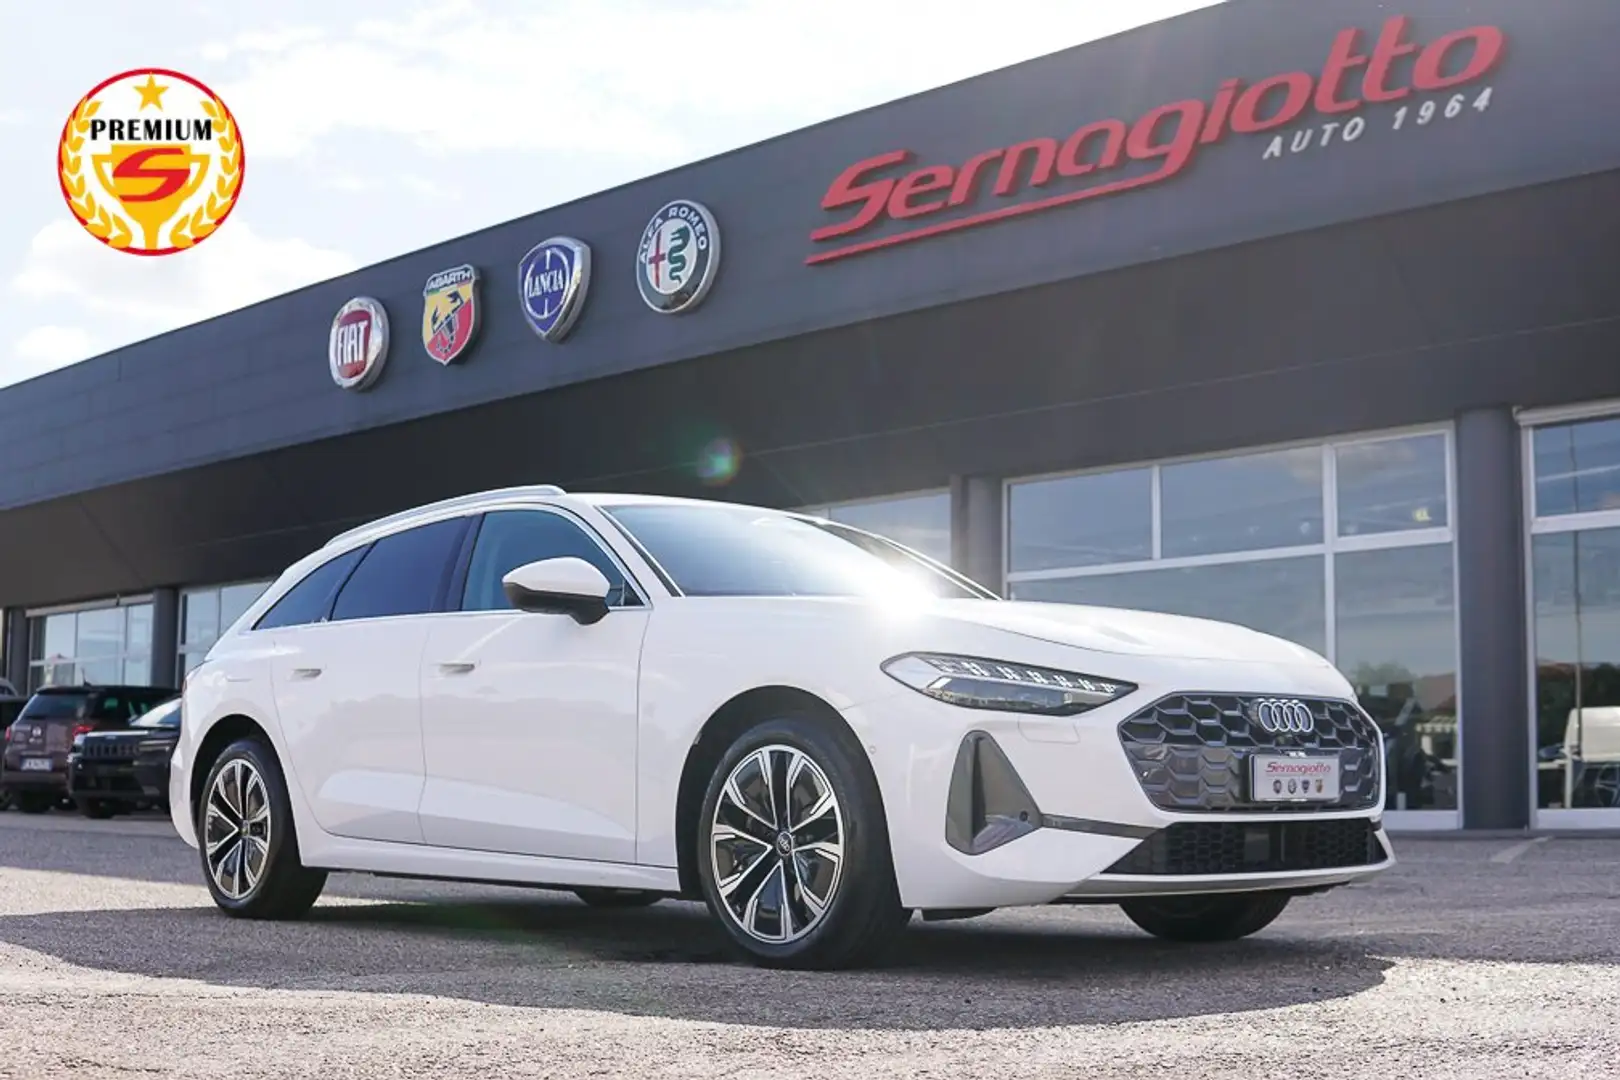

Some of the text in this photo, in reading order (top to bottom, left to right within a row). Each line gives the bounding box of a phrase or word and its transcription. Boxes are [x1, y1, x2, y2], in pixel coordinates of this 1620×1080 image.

[805, 14, 1506, 264] Sernagiotto
[1262, 87, 1493, 160] AUTO 1964
[668, 206, 708, 250] ROMEO
[427, 270, 472, 290] ABARTH
[528, 268, 564, 298] LANCIA
[337, 320, 368, 366] FIAT
